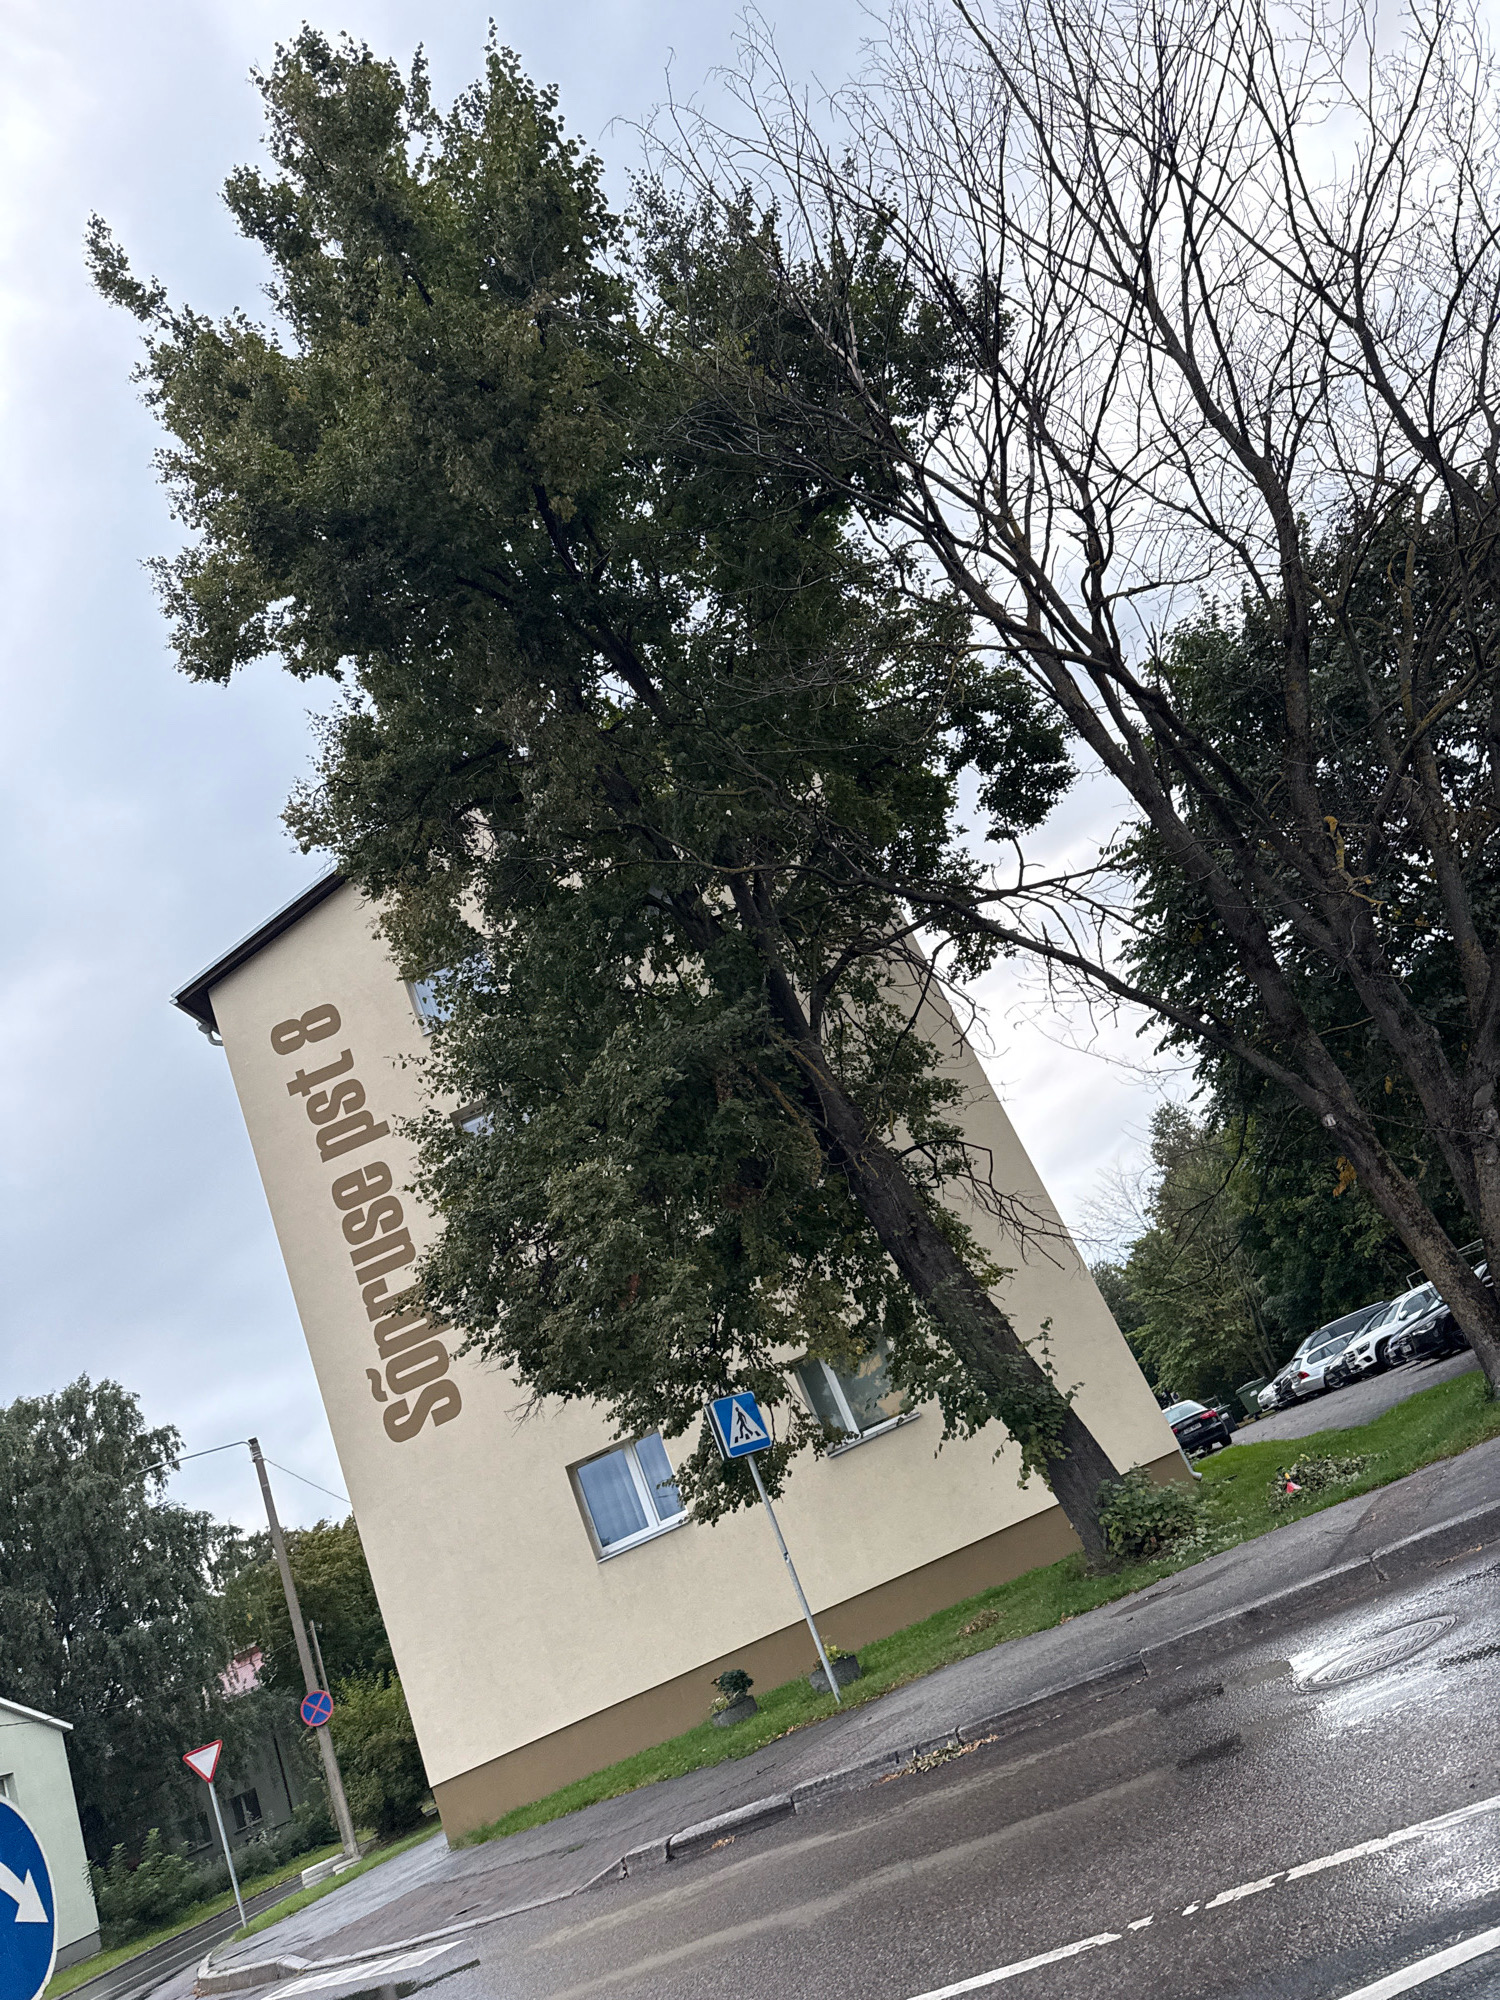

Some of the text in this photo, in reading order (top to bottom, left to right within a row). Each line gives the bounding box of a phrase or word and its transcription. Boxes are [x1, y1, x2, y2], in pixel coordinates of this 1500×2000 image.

[270, 1003, 462, 1443] Sõpruse pst 8
